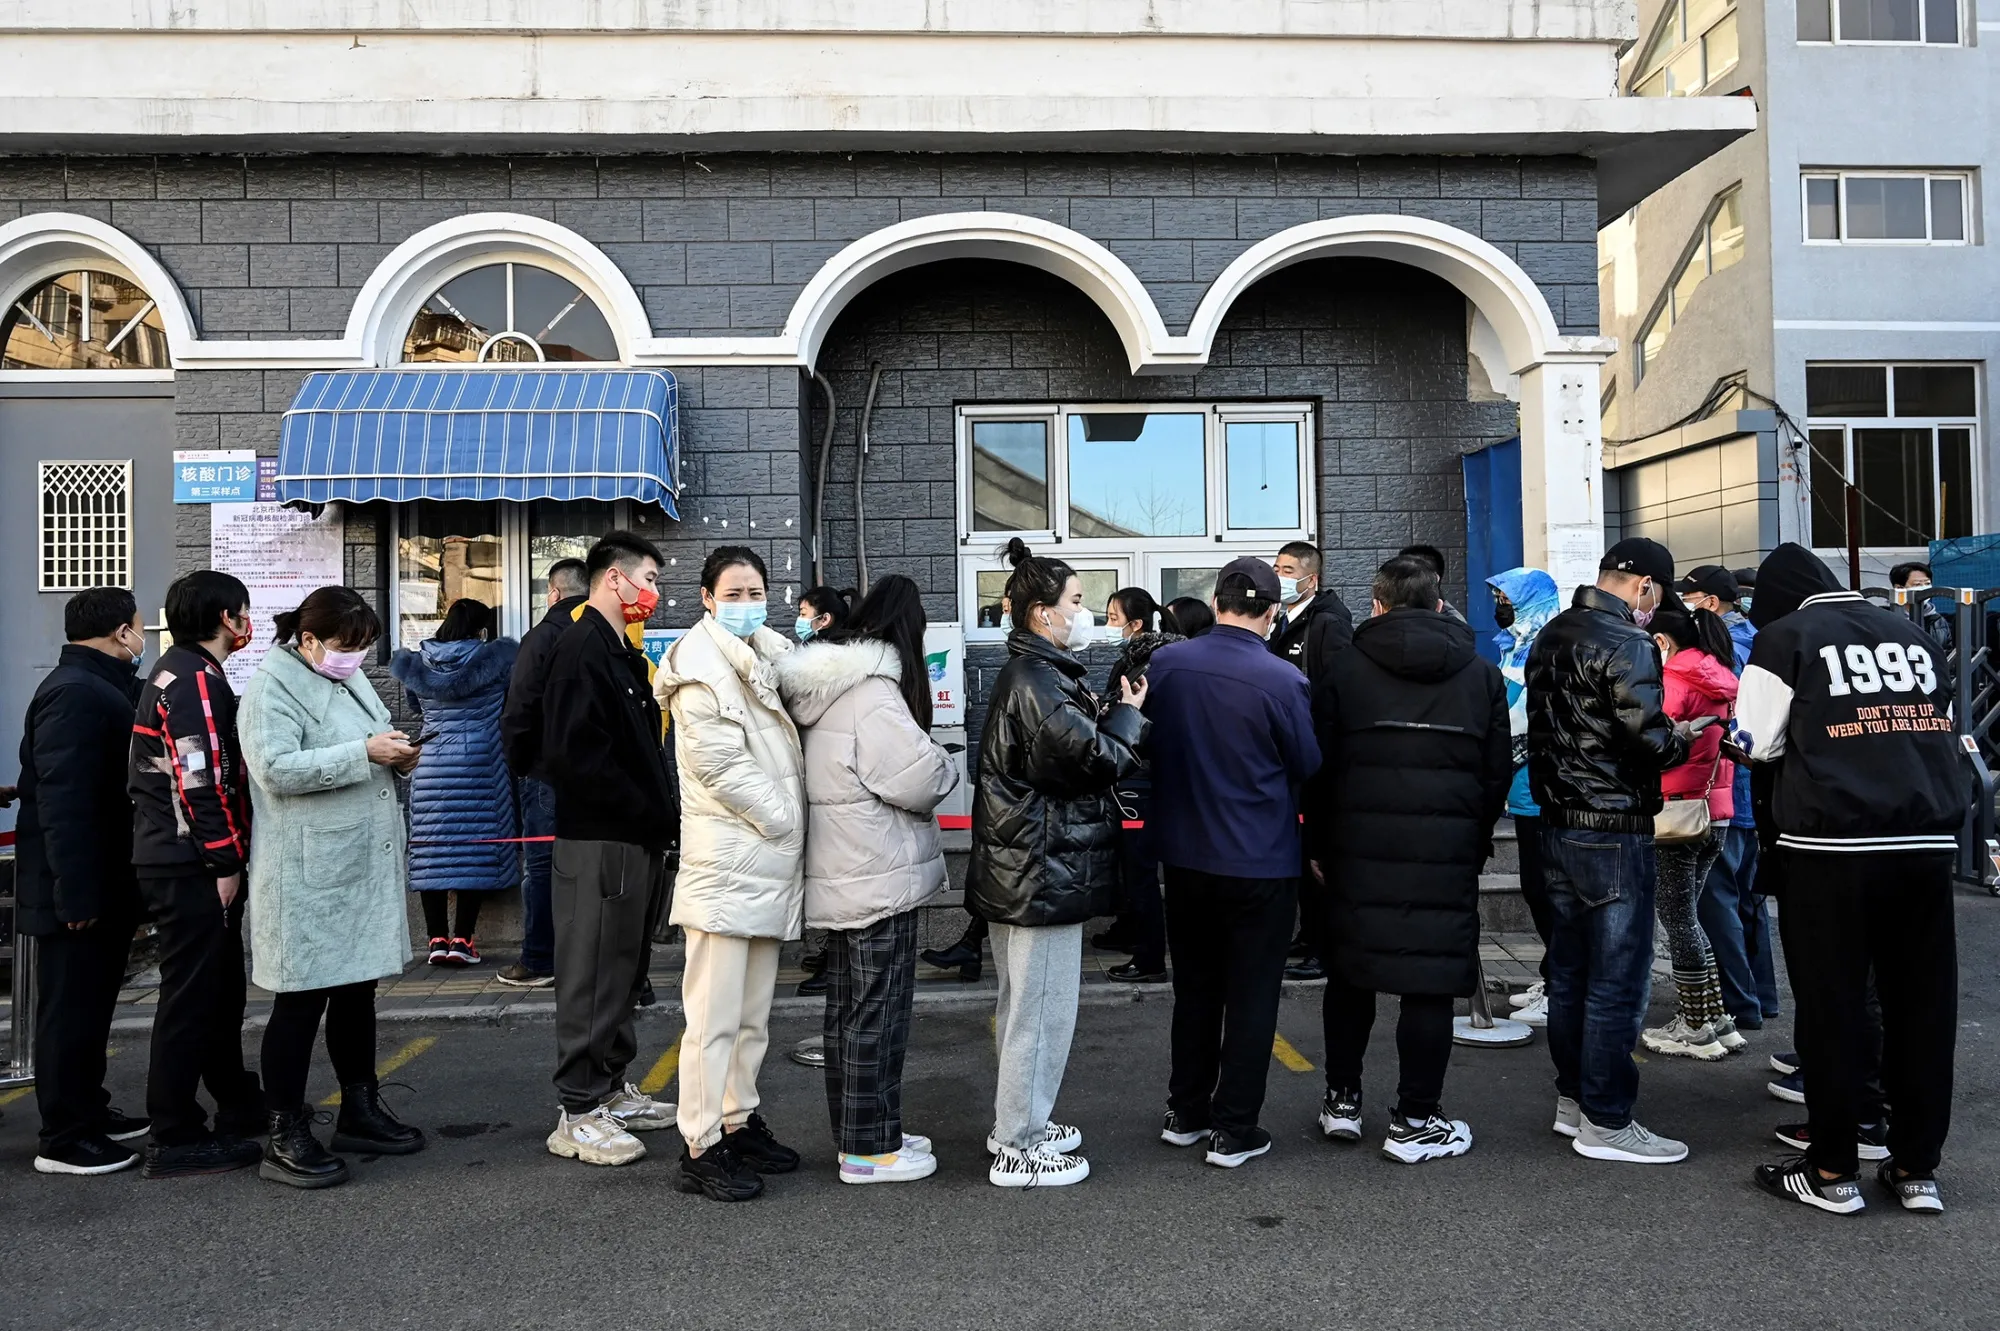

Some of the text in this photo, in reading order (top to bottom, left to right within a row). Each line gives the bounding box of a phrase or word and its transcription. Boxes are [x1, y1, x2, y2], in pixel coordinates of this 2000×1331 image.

[181, 466, 251, 482] 核酸门诊
[191, 487, 241, 496] 第三采样点
[233, 514, 327, 522] 新冠病毒核酸检测门诊
[1819, 642, 1937, 697] 1993
[1856, 703, 1935, 720] DON'T GIVE UP
[1826, 722, 1863, 738] WEEN
[1864, 719, 1889, 734] YOU
[1892, 718, 1912, 732] ARE
